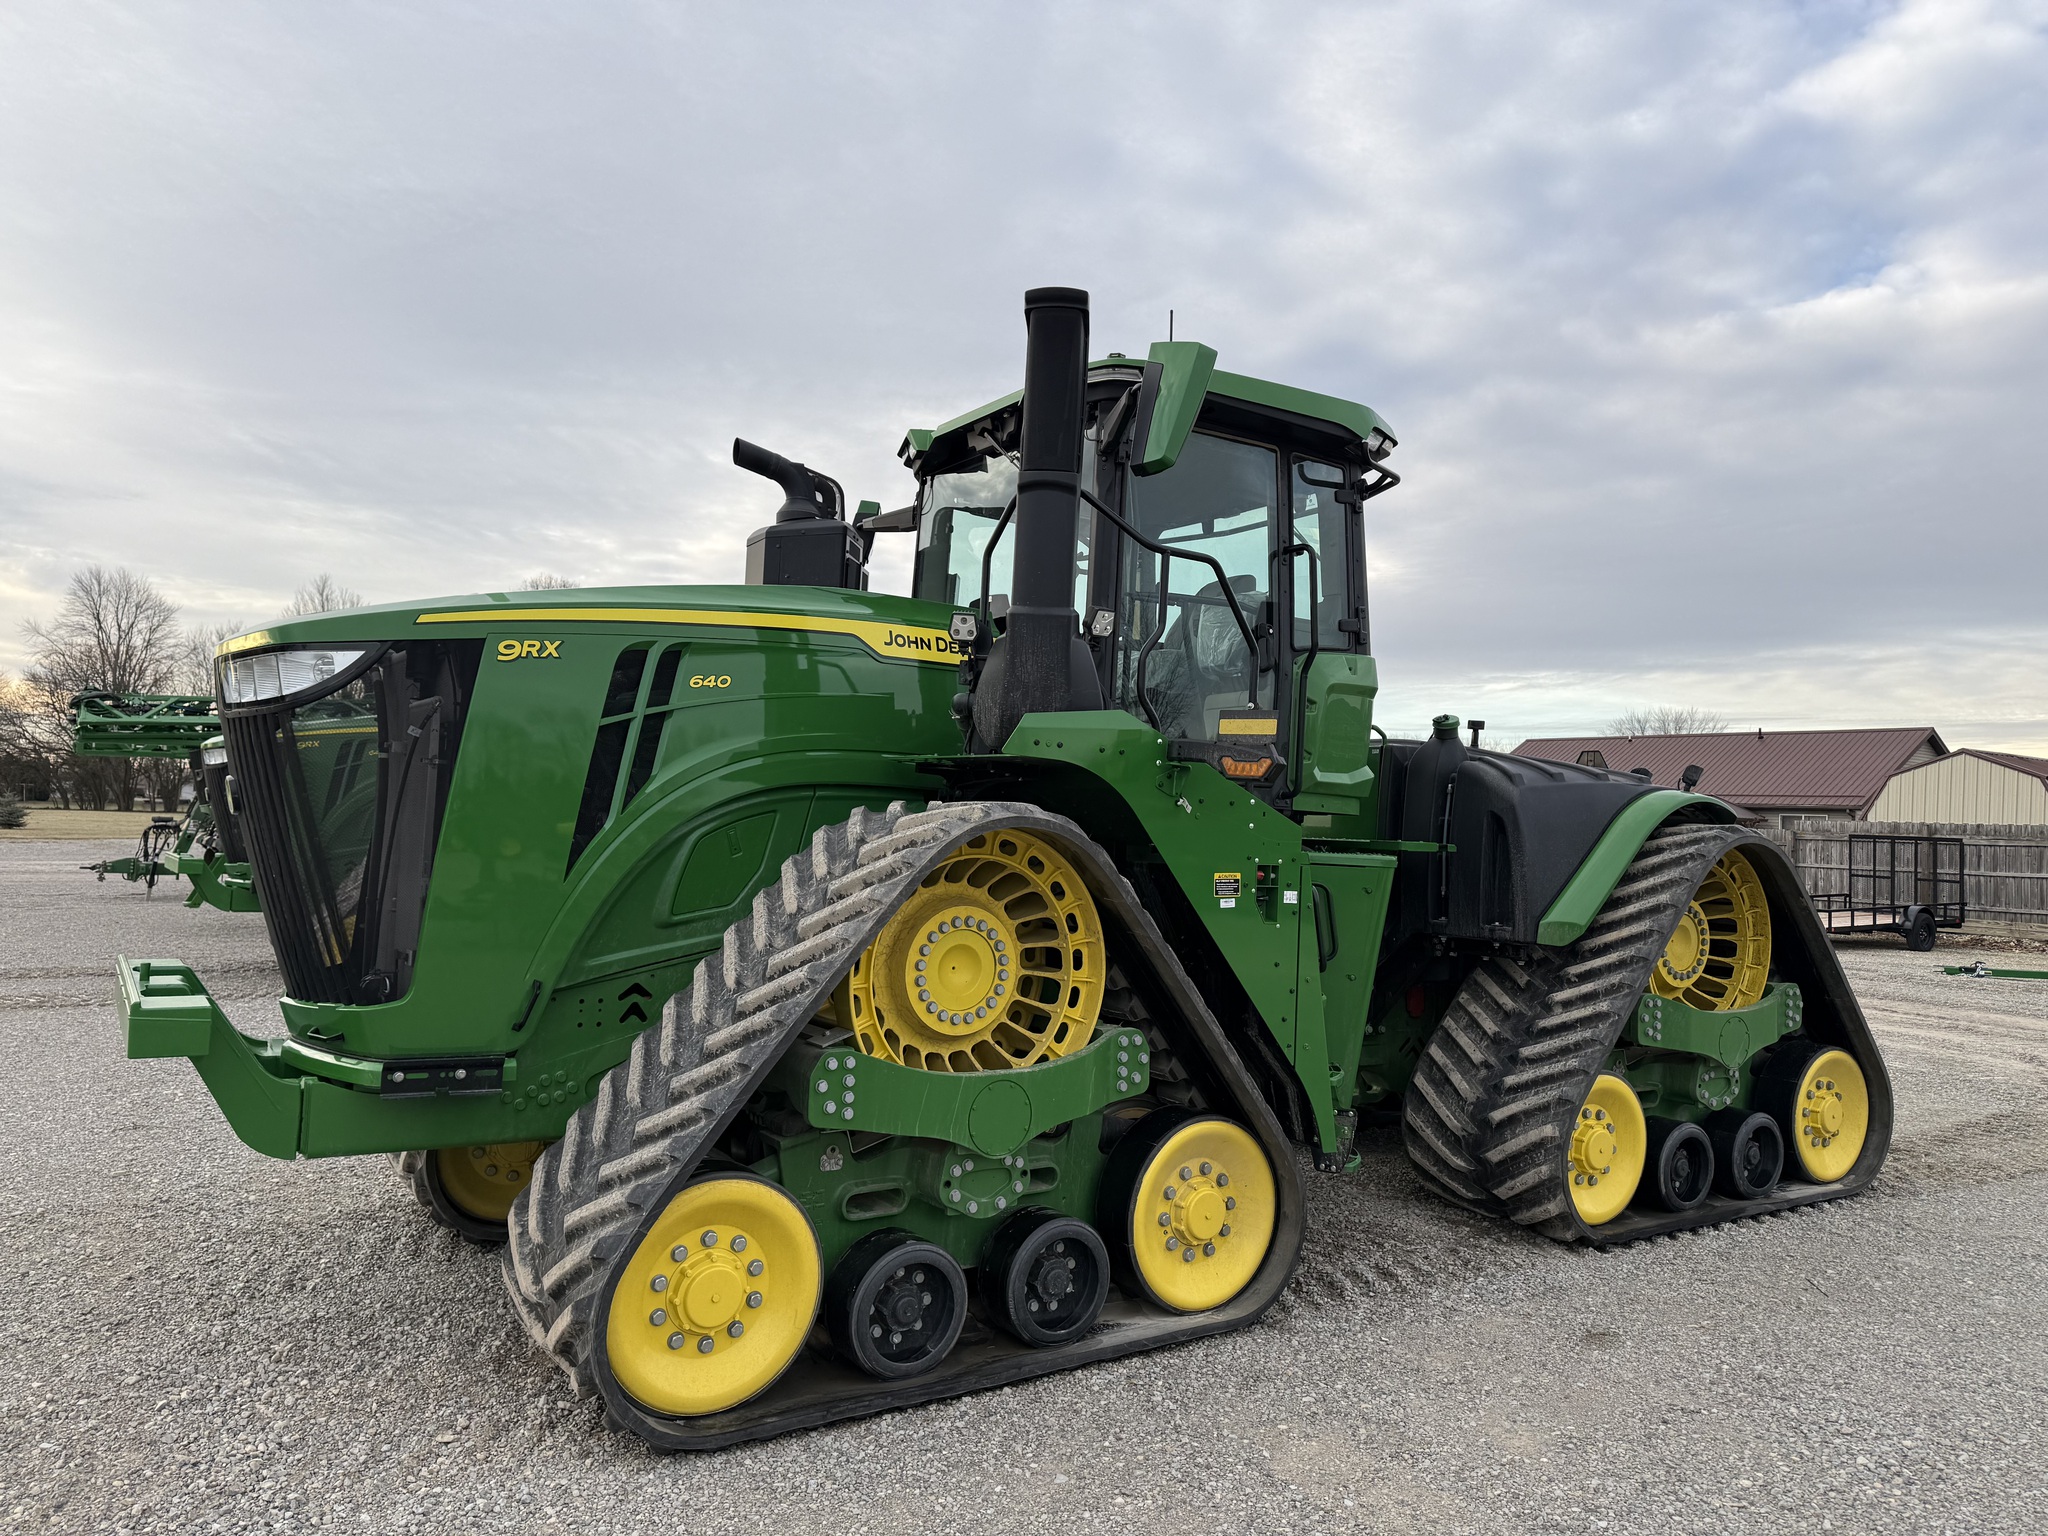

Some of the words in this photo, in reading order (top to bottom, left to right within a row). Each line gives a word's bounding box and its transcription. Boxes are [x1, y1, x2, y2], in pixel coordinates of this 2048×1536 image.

[884, 630, 932, 651] JOHN
[497, 639, 563, 661] 9RX
[689, 674, 732, 688] 640
[297, 740, 320, 750] 9RX
